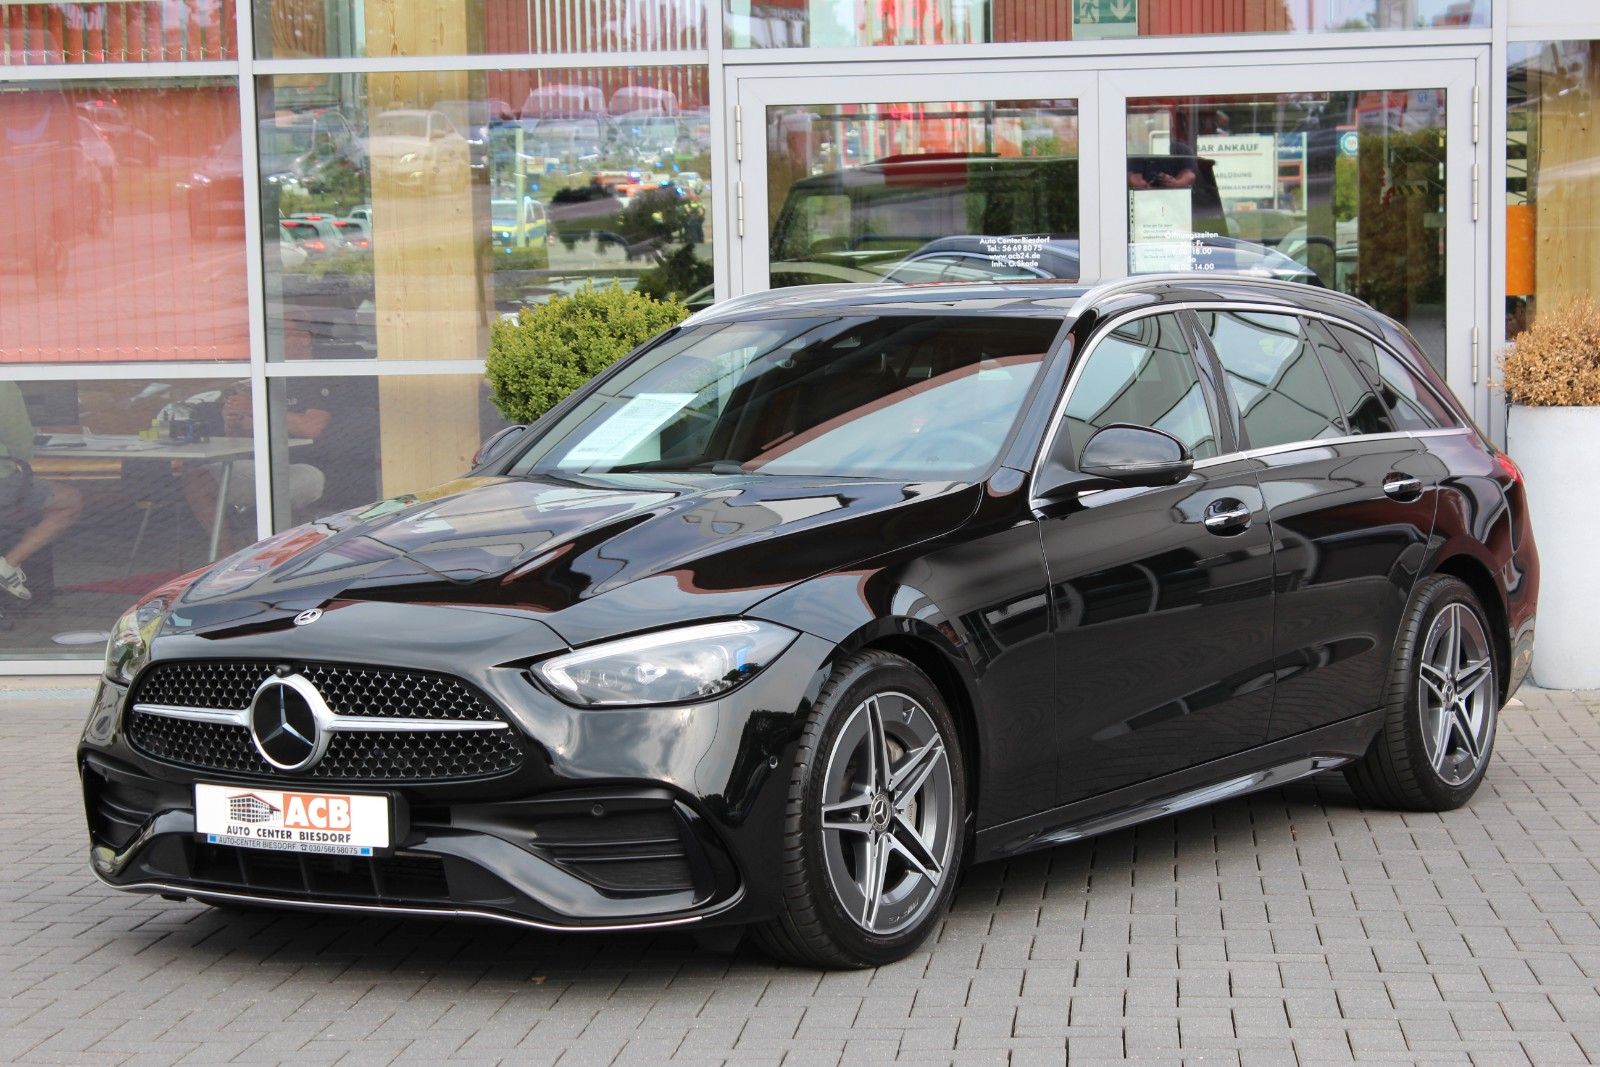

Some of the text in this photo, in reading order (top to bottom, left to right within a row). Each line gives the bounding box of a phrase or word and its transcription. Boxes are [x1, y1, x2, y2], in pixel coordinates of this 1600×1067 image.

[1217, 143, 1260, 152] ANKAUF
[997, 236, 1021, 244] Center
[1021, 235, 1050, 244] Biesdorf
[989, 252, 1041, 260] www.acb24.de
[284, 796, 350, 829] ACB
[226, 825, 351, 843] AUTO CENTER BIESDORF
[219, 836, 261, 848] AUTO-CENTER
[262, 841, 297, 850] BIESDORF
